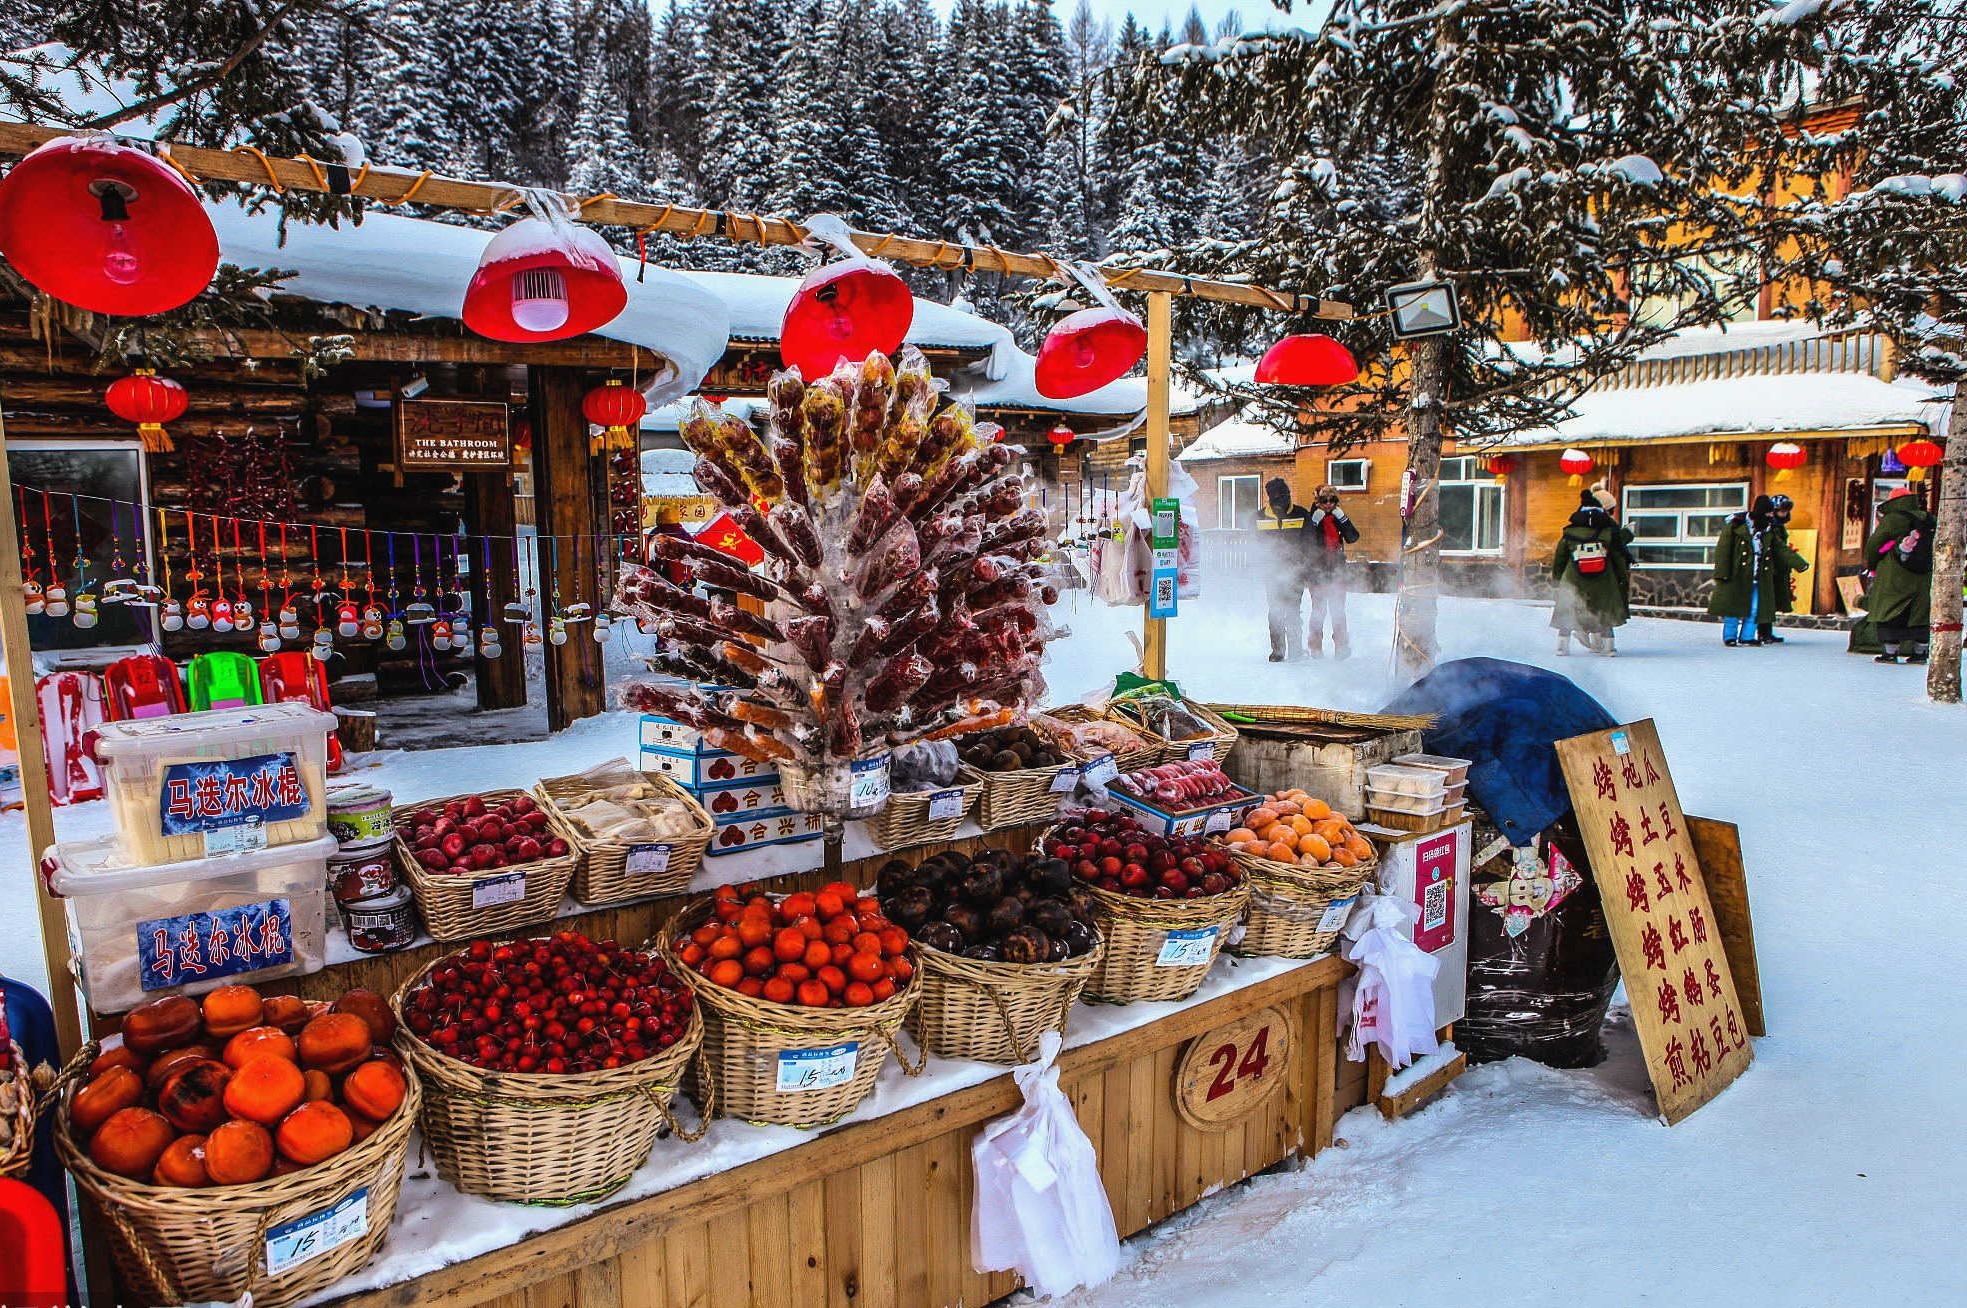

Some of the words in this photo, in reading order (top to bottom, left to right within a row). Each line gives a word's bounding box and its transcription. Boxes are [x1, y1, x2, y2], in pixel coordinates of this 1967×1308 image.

[415, 439, 436, 447] THE
[440, 439, 497, 448] BATHROOM
[168, 765, 302, 819] 马迭尔冰棍
[1592, 747, 1661, 802] 烤地瓜
[1609, 801, 1678, 858] 烤土豆
[1625, 851, 1692, 913] 烤玉米
[152, 909, 286, 980] 马迭尔冰棍
[1641, 905, 1708, 971] 烤红肠
[1205, 1025, 1270, 1103] 24
[1663, 1003, 1747, 1095] 煎粘豆包
[799, 1068, 821, 1088] 15
[290, 1230, 320, 1258] 15
